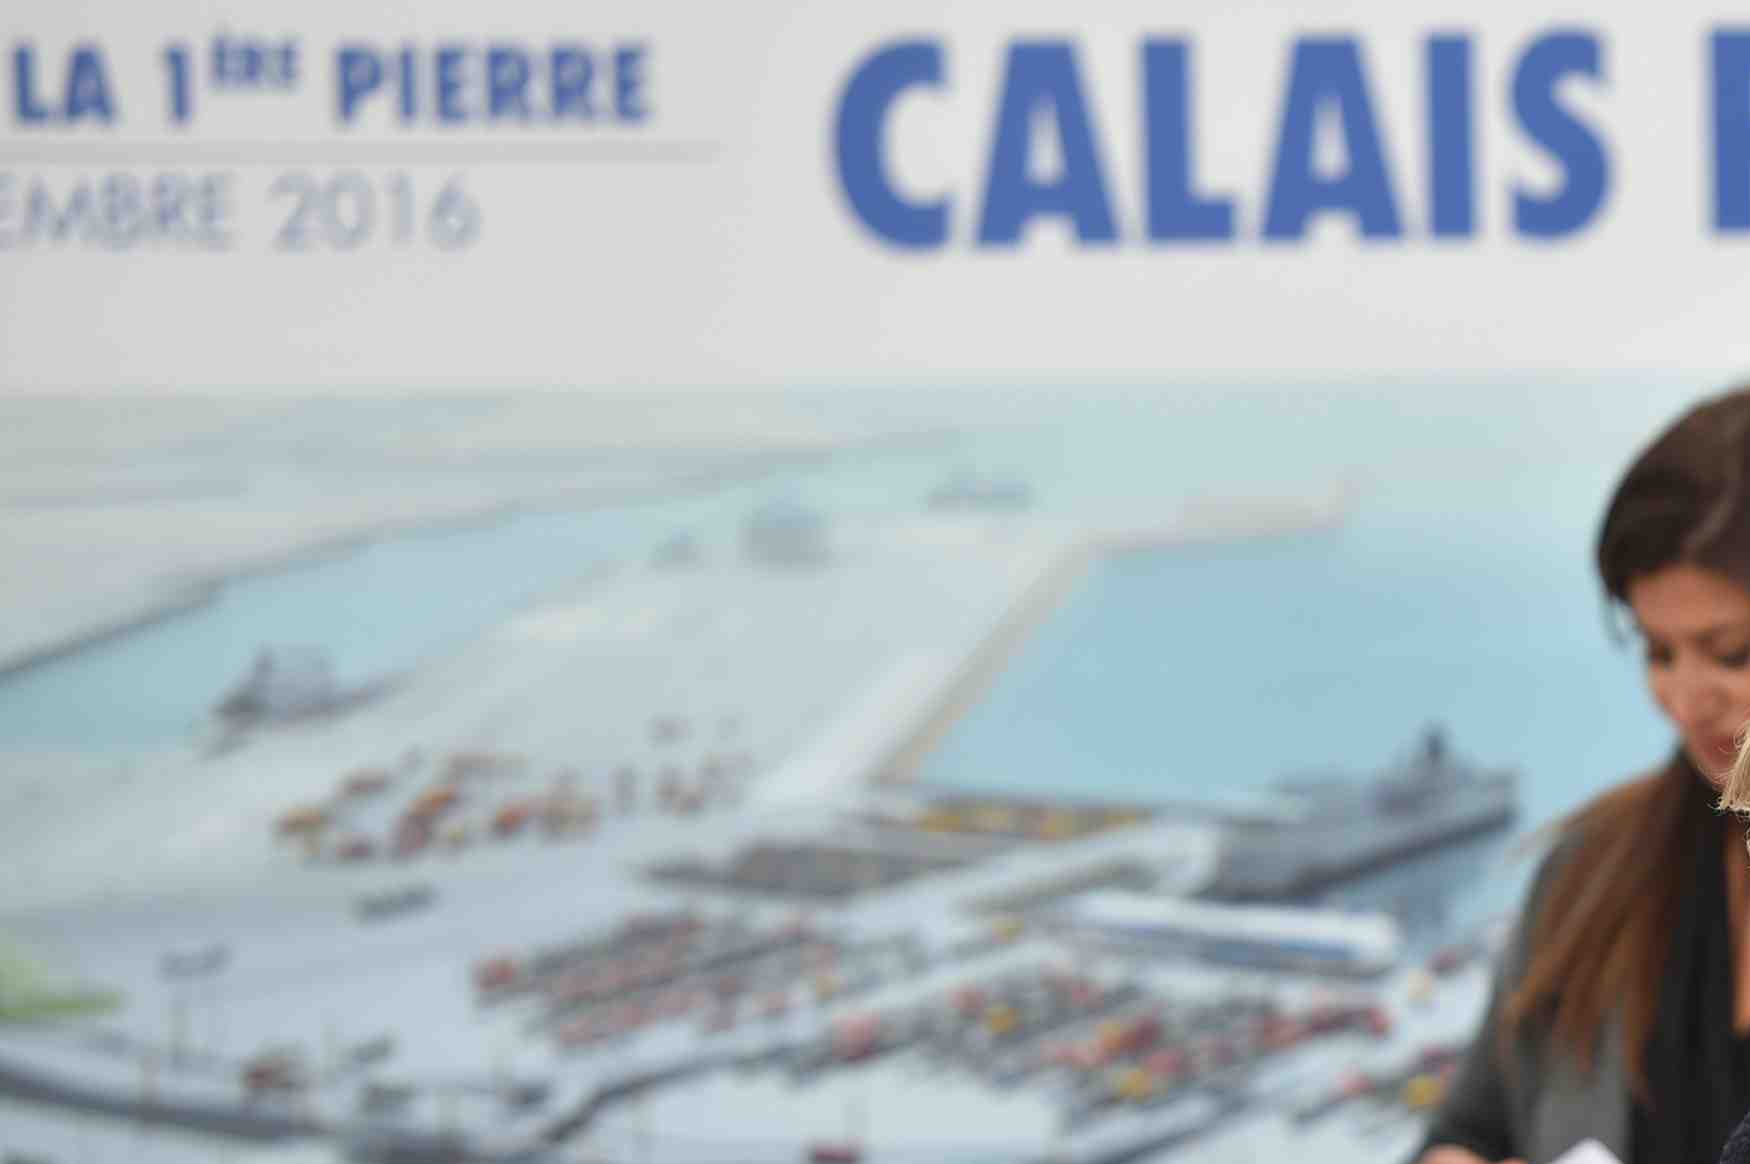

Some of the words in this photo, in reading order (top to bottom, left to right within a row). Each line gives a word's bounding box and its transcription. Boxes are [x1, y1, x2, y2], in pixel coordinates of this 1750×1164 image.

[12, 42, 115, 127] LA
[334, 43, 650, 127] PIERRE
[830, 26, 1614, 251] CALAIS
[267, 172, 482, 252] 2016
